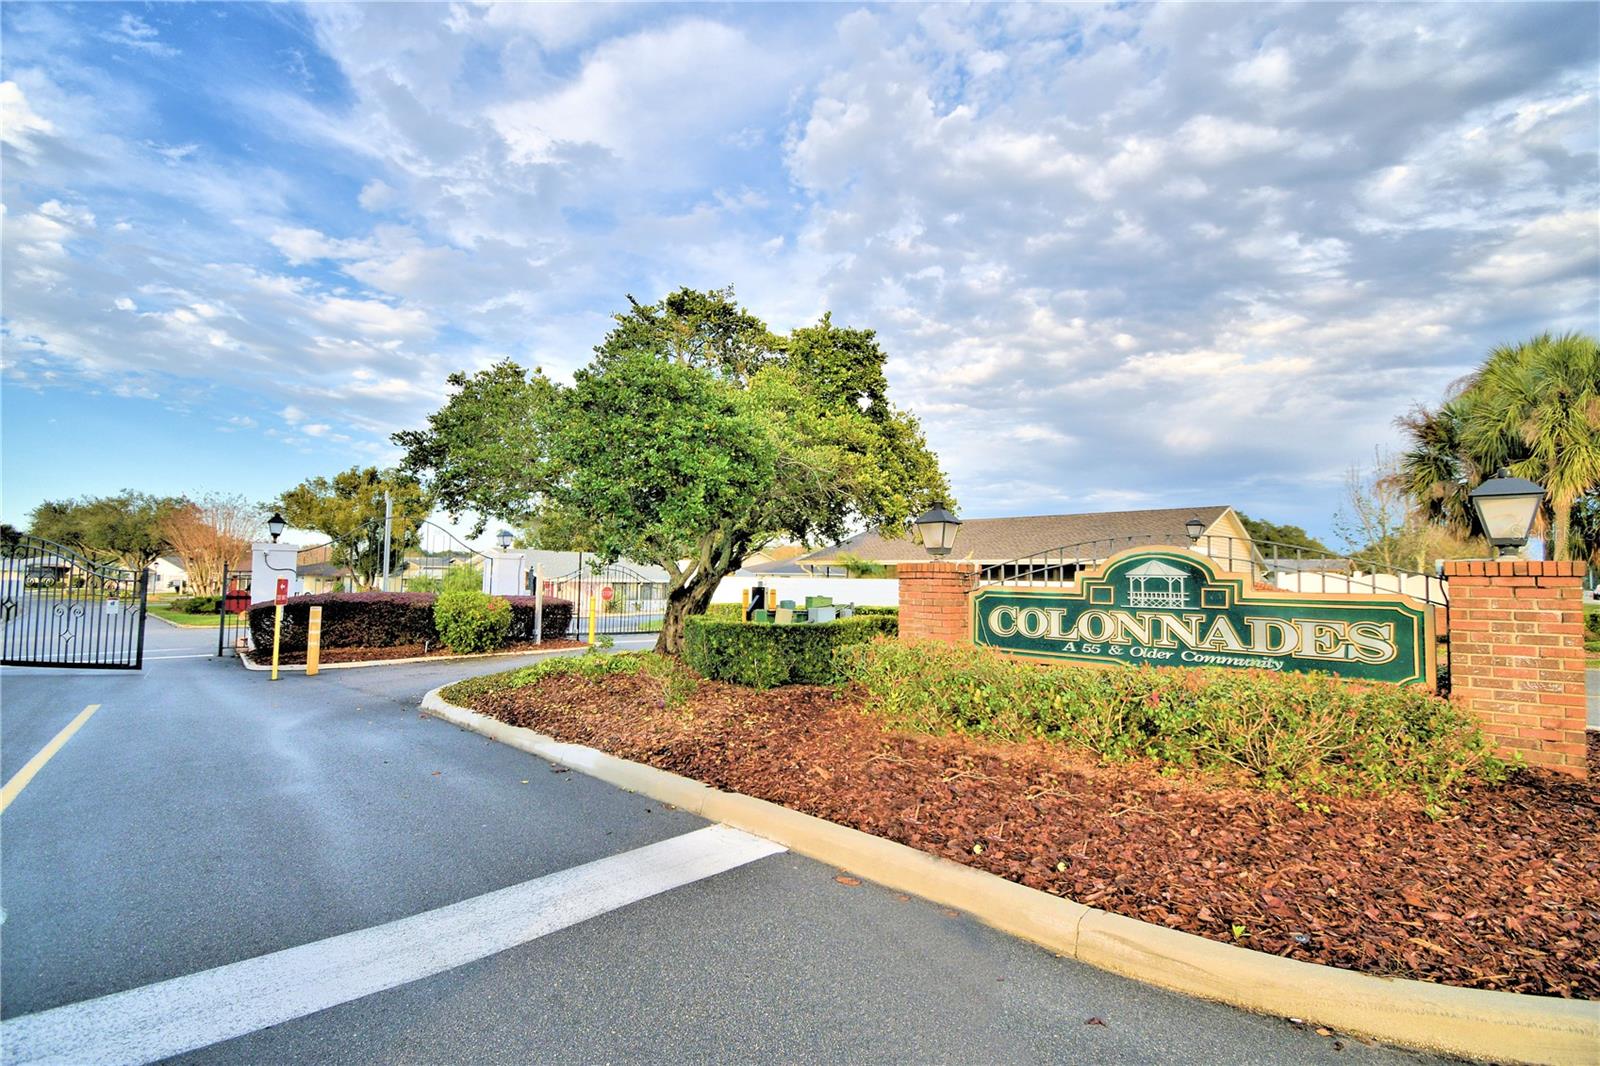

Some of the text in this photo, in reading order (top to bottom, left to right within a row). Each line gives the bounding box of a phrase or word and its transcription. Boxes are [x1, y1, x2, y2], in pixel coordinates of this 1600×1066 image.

[988, 605, 1397, 665] COLONNADES
[1062, 642, 1284, 671] A 55 & Older Community
